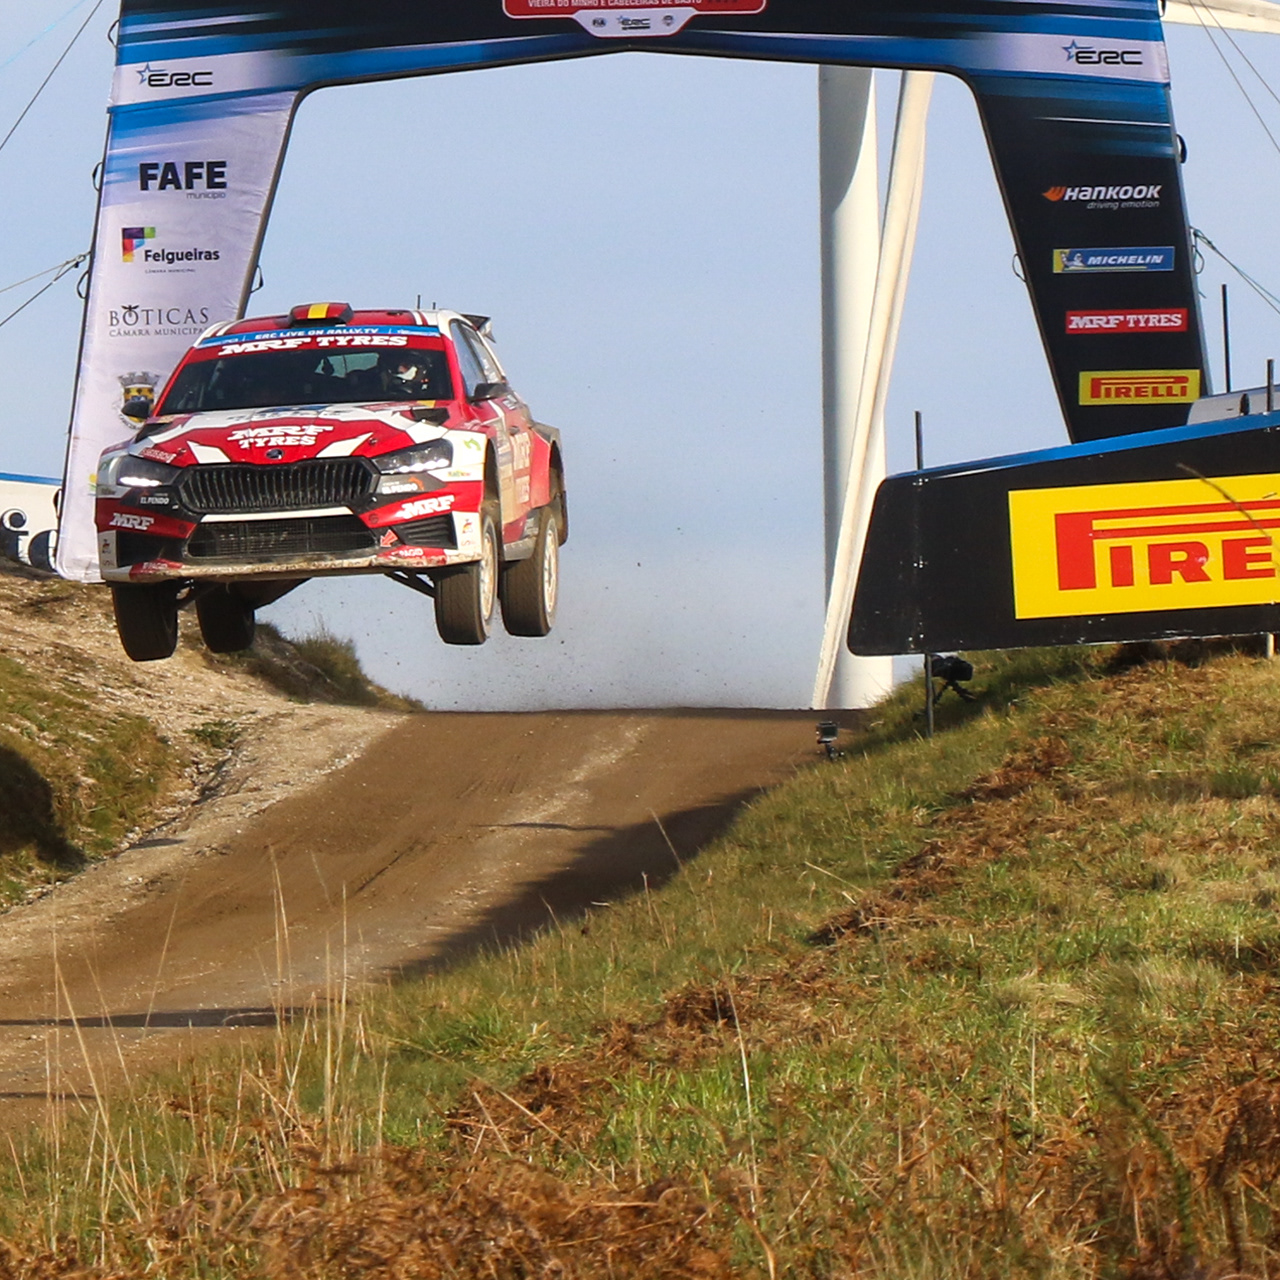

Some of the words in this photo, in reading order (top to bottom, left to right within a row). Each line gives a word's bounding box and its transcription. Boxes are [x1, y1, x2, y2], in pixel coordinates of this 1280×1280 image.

[528, 0, 556, 7] VIEIRA
[557, 0, 569, 7] DO
[1075, 50, 1143, 65] ERC
[147, 71, 213, 87] ERC
[139, 161, 227, 191] FAFE
[1087, 201, 1119, 210] driving
[1121, 200, 1160, 208] emotion
[144, 248, 220, 264] Felgueiras
[1087, 254, 1164, 265] MICHELIN
[109, 306, 209, 326] BOTICAS
[1068, 315, 1124, 329] MRF
[1127, 314, 1182, 327] TYRES
[109, 328, 151, 337] CÂMARA
[154, 327, 209, 336] MUNICIPA
[255, 332, 277, 340] ERC
[218, 337, 311, 356] MRF
[316, 335, 408, 347] TYRES
[1090, 376, 1189, 399] PIRELLI
[228, 425, 333, 441] MRF
[239, 436, 316, 449] TYRES
[399, 494, 455, 520] MRF
[109, 512, 154, 531] MRF
